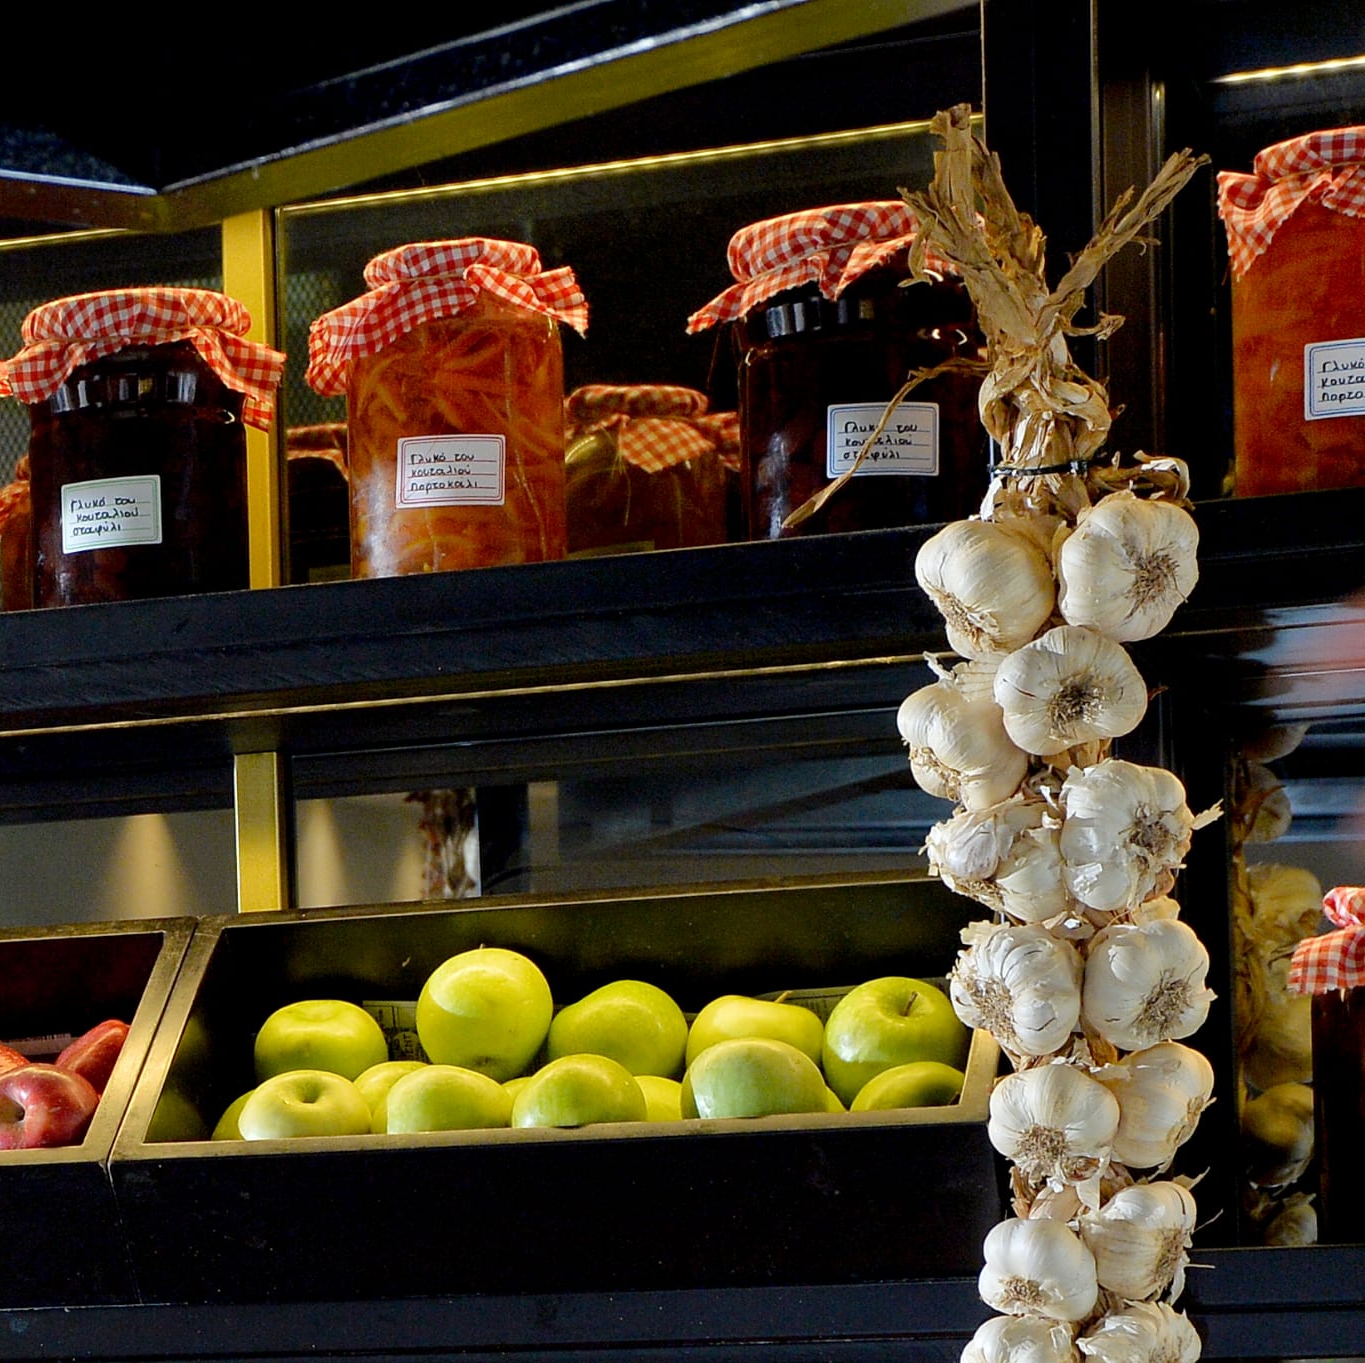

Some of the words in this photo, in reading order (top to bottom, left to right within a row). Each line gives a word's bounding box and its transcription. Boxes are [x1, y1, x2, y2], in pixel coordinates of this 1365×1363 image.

[845, 421, 879, 433] Γλυκ
[896, 424, 917, 433] του
[410, 452, 446, 465] Γλυκό
[454, 453, 474, 462] του
[411, 464, 471, 477] κουταλιού
[70, 497, 105, 513] Γλυκό
[115, 497, 136, 505] του
[76, 507, 139, 522] κουταλιού
[73, 521, 121, 536] σταφύλι
